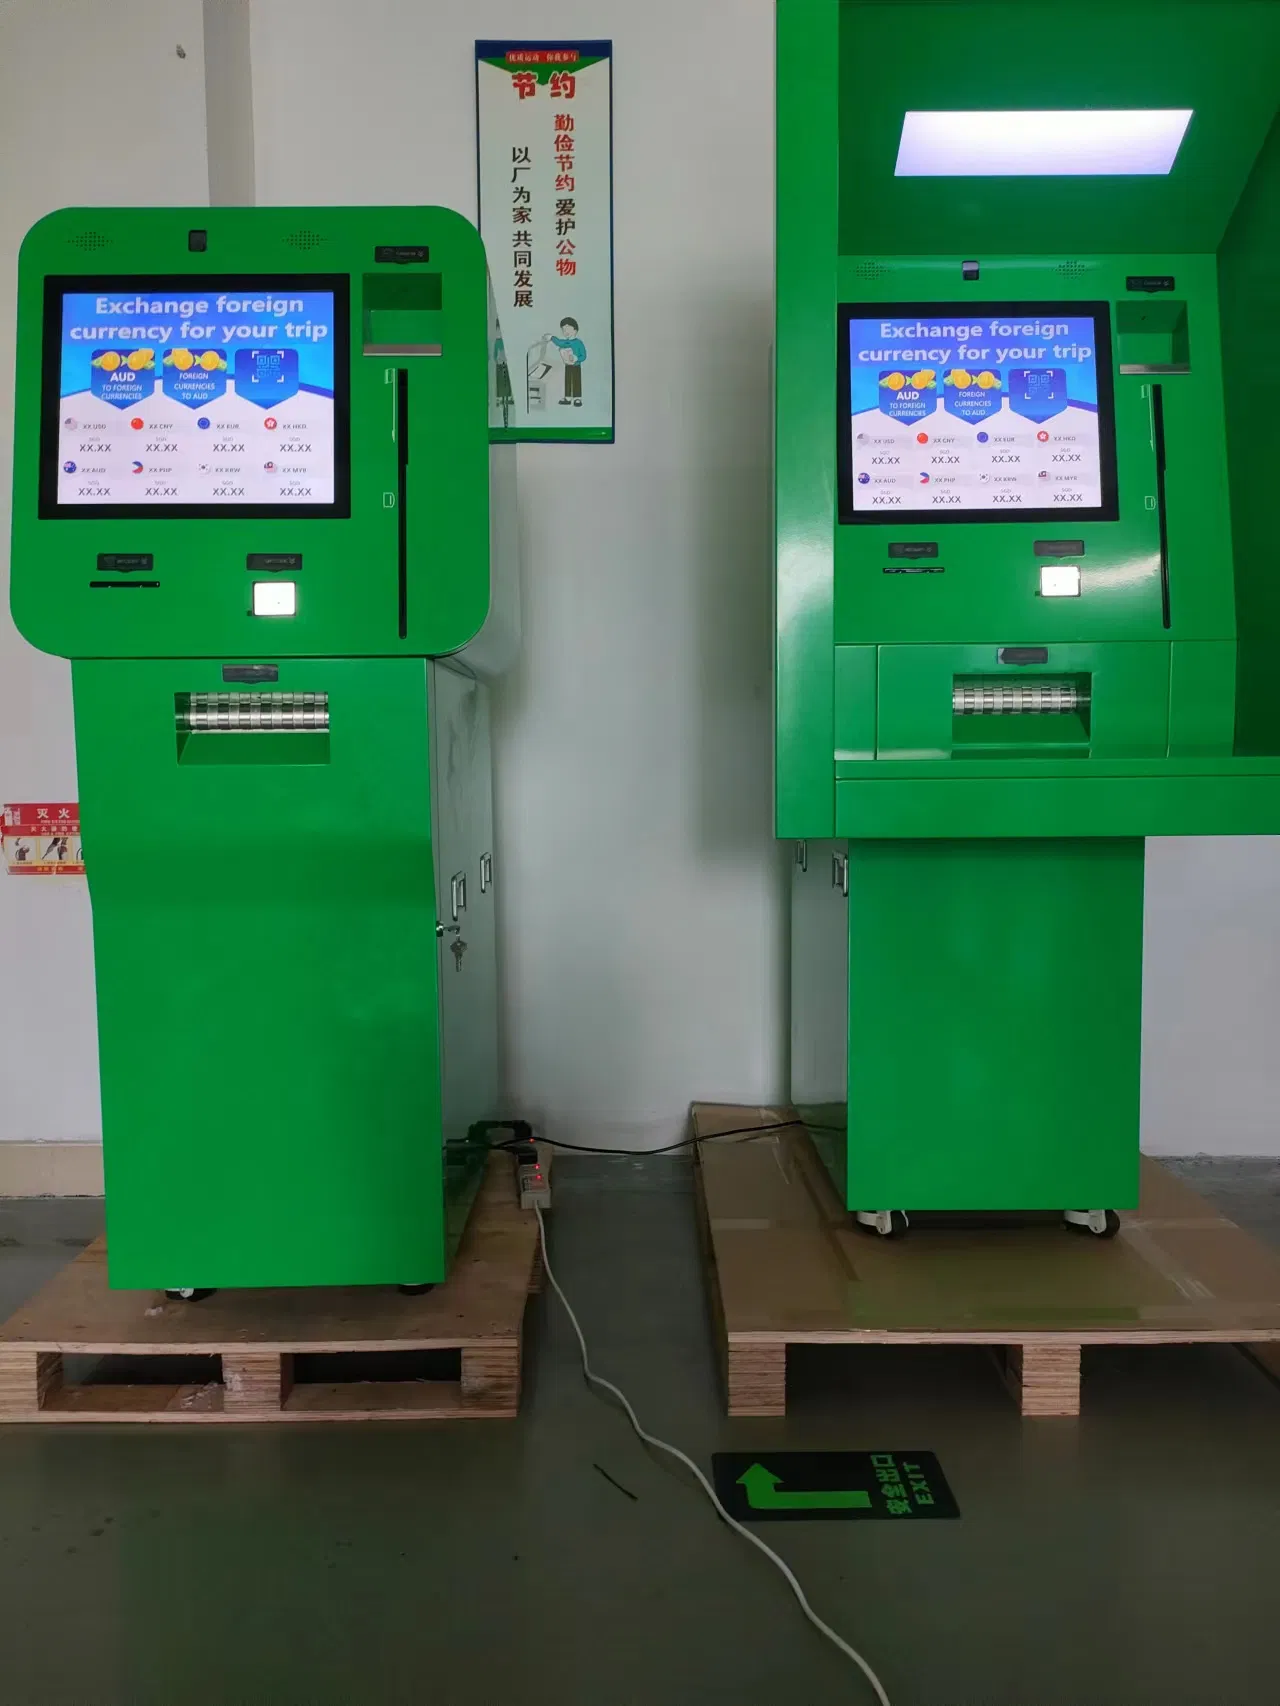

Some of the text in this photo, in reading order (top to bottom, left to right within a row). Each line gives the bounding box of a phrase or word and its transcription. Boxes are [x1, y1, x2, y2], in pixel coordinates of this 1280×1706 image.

[511, 71, 576, 99] 节约
[553, 113, 577, 276] 勤俭节约 爱护公物
[511, 146, 533, 308] 以厂为家 共同发展
[96, 296, 304, 318] Exchange foreign
[70, 321, 327, 342] currency for your trip
[881, 321, 1068, 341] Exchange foreign
[858, 344, 1091, 363] currency for your trip
[111, 372, 135, 382] AUD
[897, 392, 919, 400] AUD
[80, 444, 111, 452] XX.XX
[146, 444, 178, 452] XX.XX
[213, 444, 245, 452] XX.XX
[280, 444, 311, 452] XX.XX
[78, 488, 110, 496] XX.XX
[145, 488, 177, 496] XX.XX
[213, 488, 245, 496] XX.XX
[280, 488, 311, 496] XX.XX
[36, 808, 70, 819] 灭火
[870, 1454, 912, 1514] 安全出口
[902, 1461, 935, 1505] EXIT
